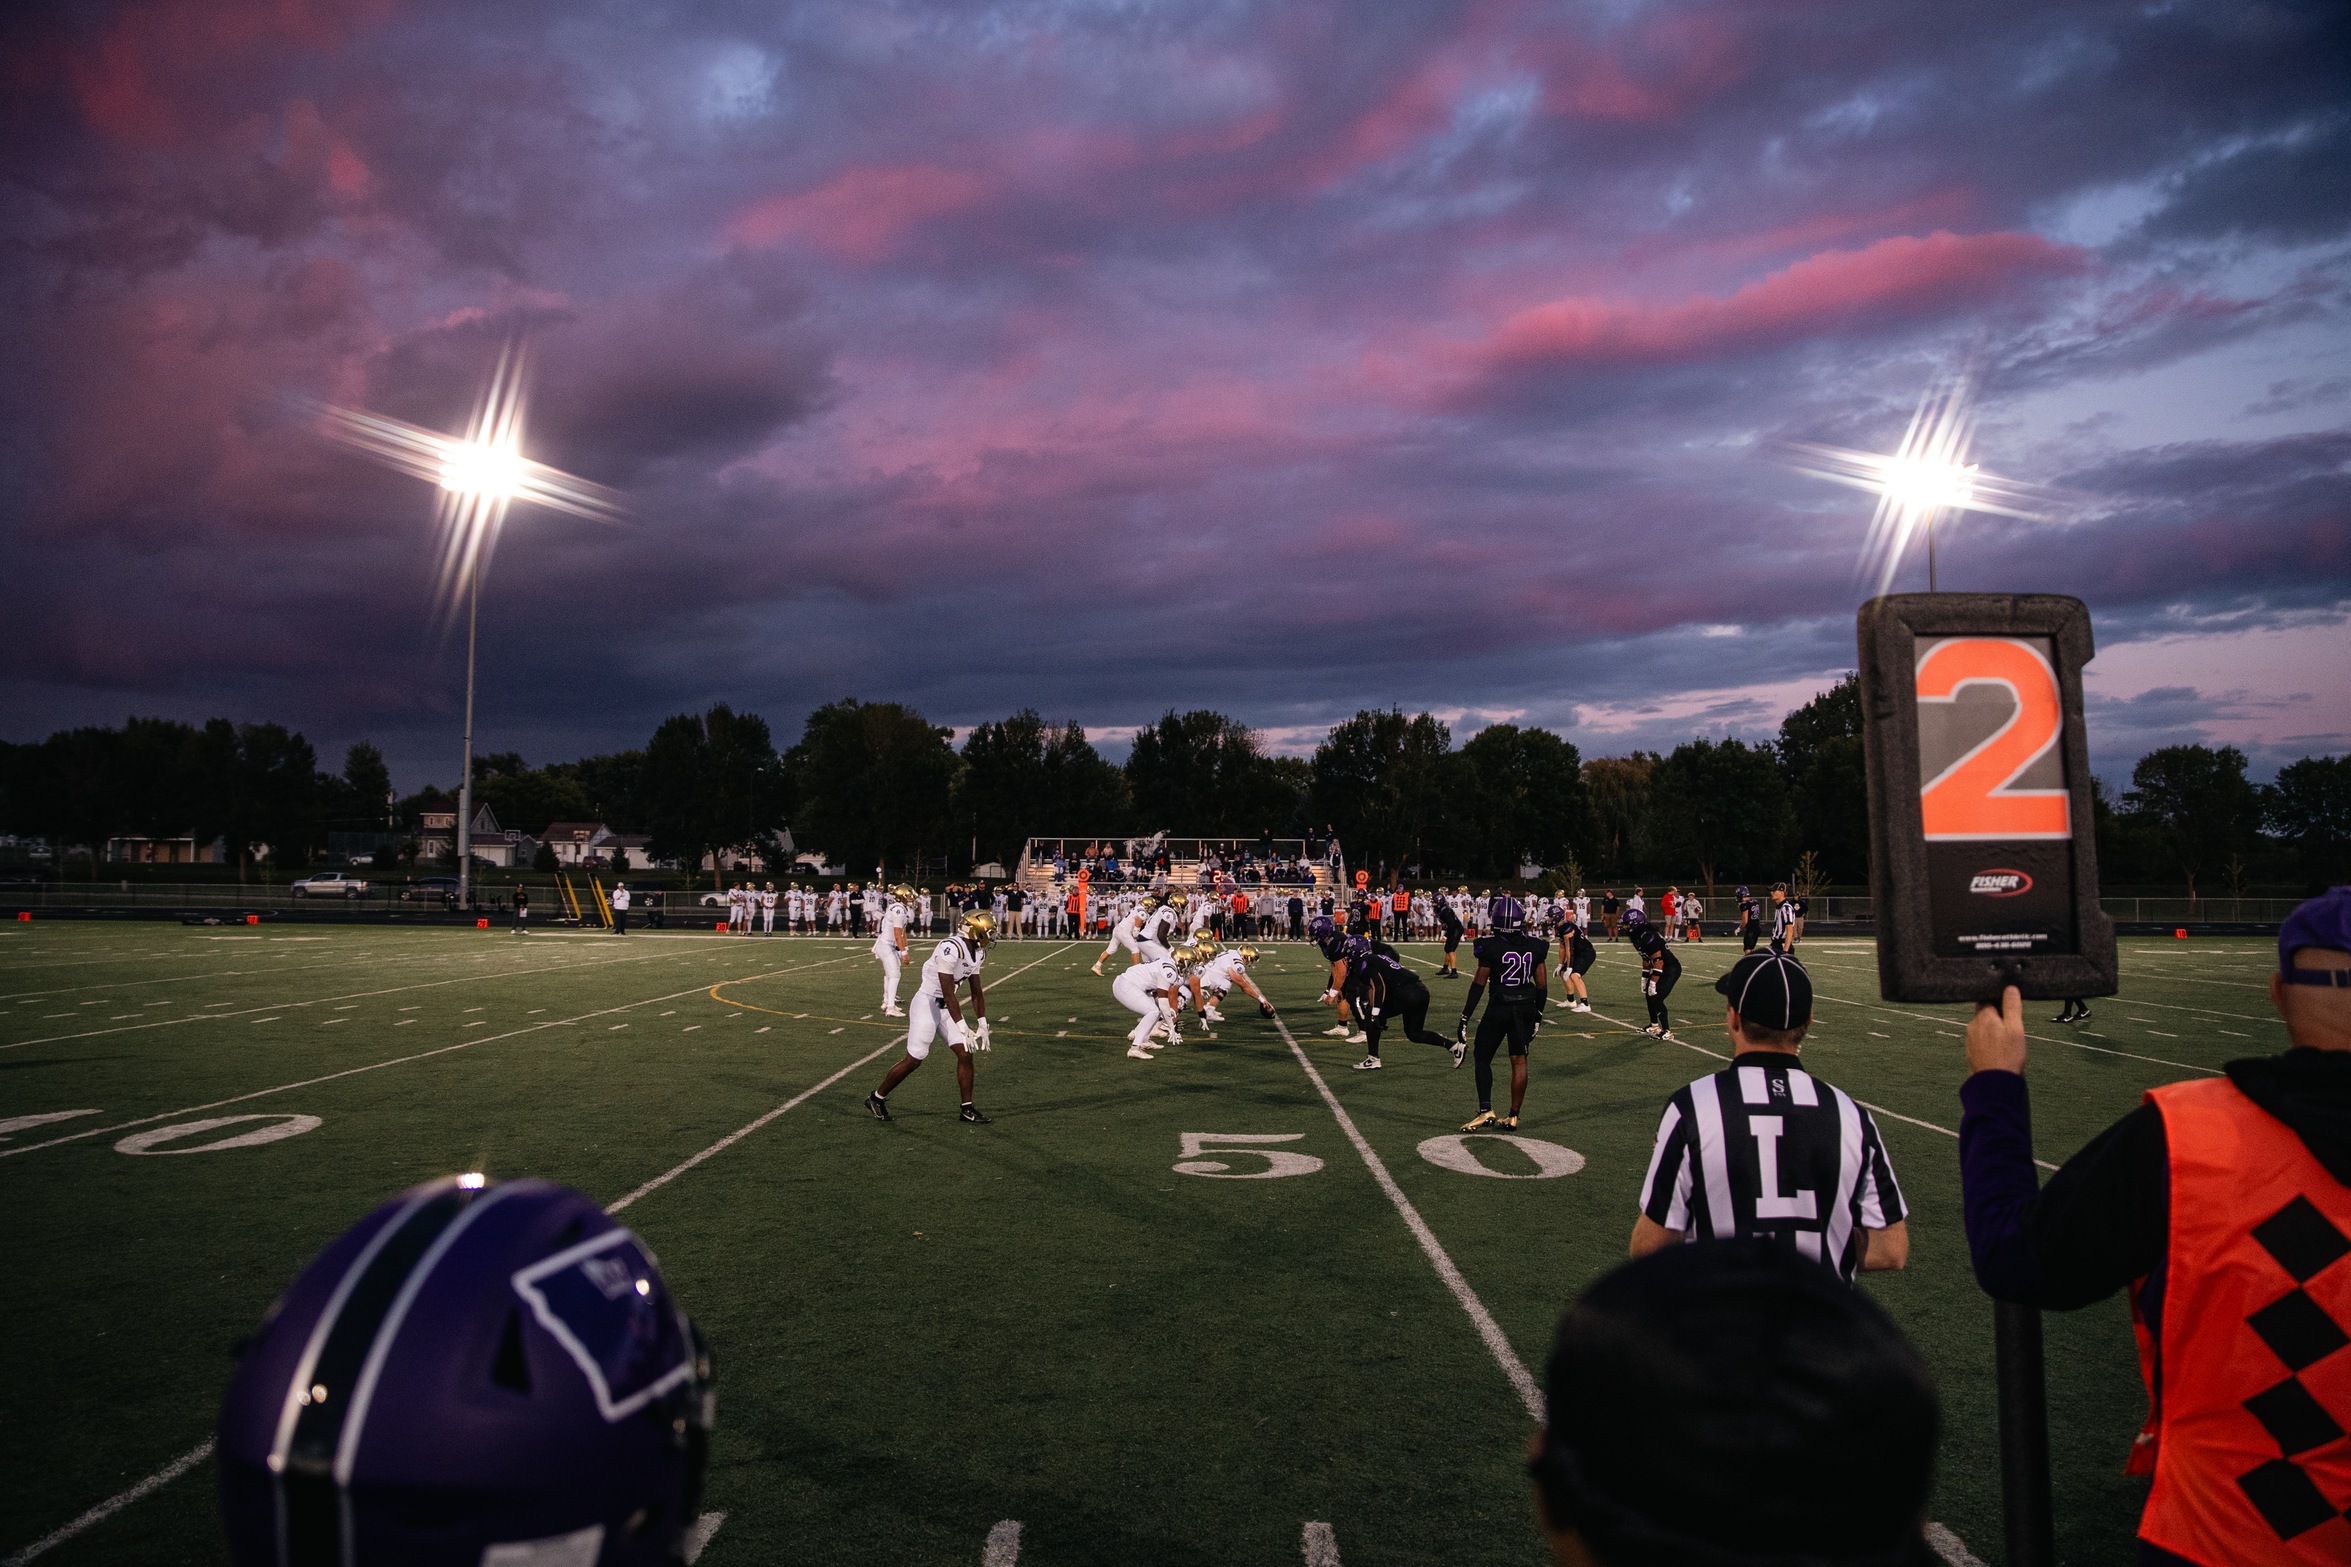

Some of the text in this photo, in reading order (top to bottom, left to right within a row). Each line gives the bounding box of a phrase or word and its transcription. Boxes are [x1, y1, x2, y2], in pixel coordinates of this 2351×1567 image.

[1914, 636, 2071, 841] 2
[1213, 870, 1221, 883] 2
[1969, 875, 2019, 888] FISHER
[717, 923, 726, 931] 30
[1690, 930, 1699, 938] 30
[2177, 930, 2186, 938] 10
[1501, 951, 1532, 986] 21
[1748, 1115, 1818, 1220] L
